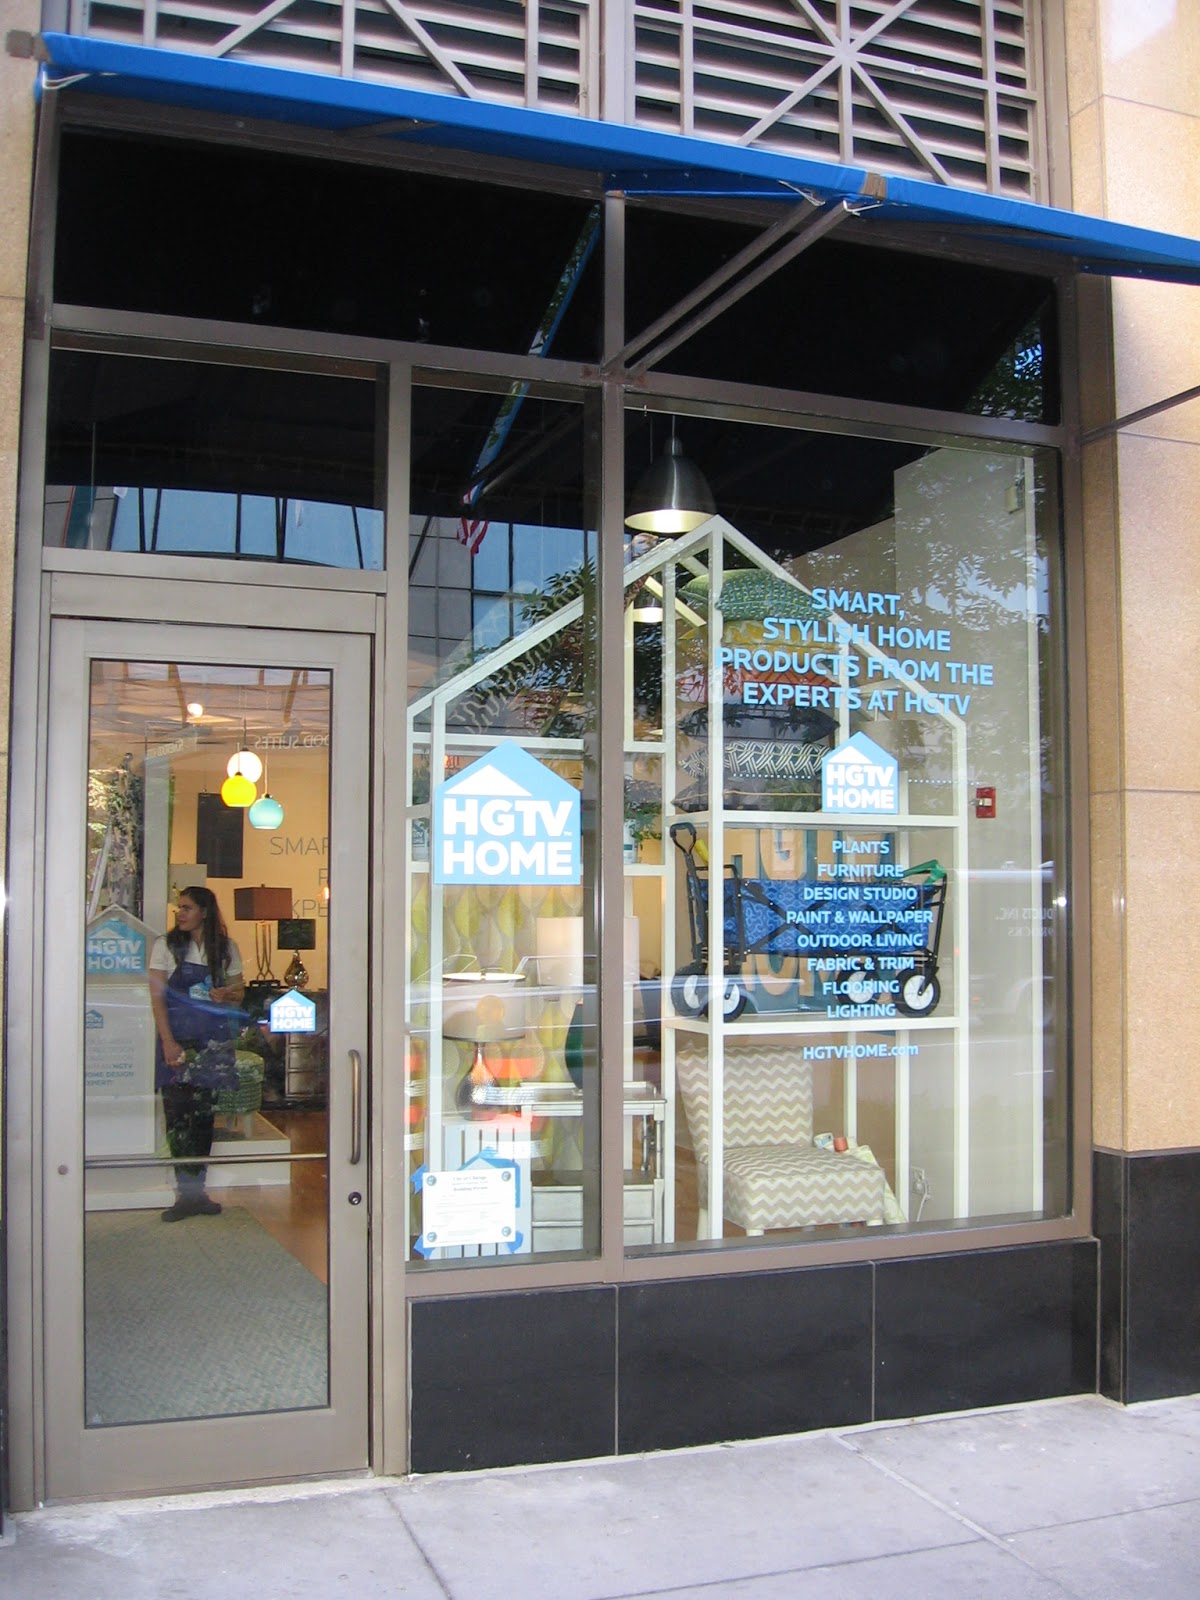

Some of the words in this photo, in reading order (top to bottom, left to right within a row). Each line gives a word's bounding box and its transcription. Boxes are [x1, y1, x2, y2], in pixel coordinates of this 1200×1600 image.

[811, 588, 905, 620] SMART,
[762, 616, 870, 647] STYLISH
[877, 627, 951, 652] HOME
[714, 647, 860, 678] PRODUCTS
[867, 656, 940, 683] FROM
[946, 662, 994, 686] THE
[742, 681, 861, 710] EXPERTS
[868, 689, 898, 712] AT
[905, 692, 970, 716] HGTV
[826, 764, 895, 787] HGTV
[826, 788, 895, 809] HOME
[443, 797, 573, 837] HGTV
[831, 840, 890, 854] PLANTS
[443, 839, 573, 876] HOME
[817, 863, 904, 878] FURNITURE
[803, 887, 859, 901] DESIGN
[863, 887, 918, 901] STUDIO
[786, 910, 831, 925] PAINT
[834, 911, 847, 924] &
[848, 910, 934, 924] WALLPAPER
[86, 939, 142, 955] HGTV
[797, 934, 872, 948] OUTDOOR
[876, 933, 923, 947] LIVING
[87, 956, 142, 970] HOME
[807, 957, 861, 971] FABRIC
[864, 957, 875, 970] &
[879, 956, 915, 970] TRIM
[822, 980, 900, 995] FLOORING
[273, 1006, 314, 1018] HGTV
[826, 1003, 896, 1018] LIGHTING
[273, 1018, 314, 1029] HOME
[803, 1044, 919, 1060] HGTVHOME.com
